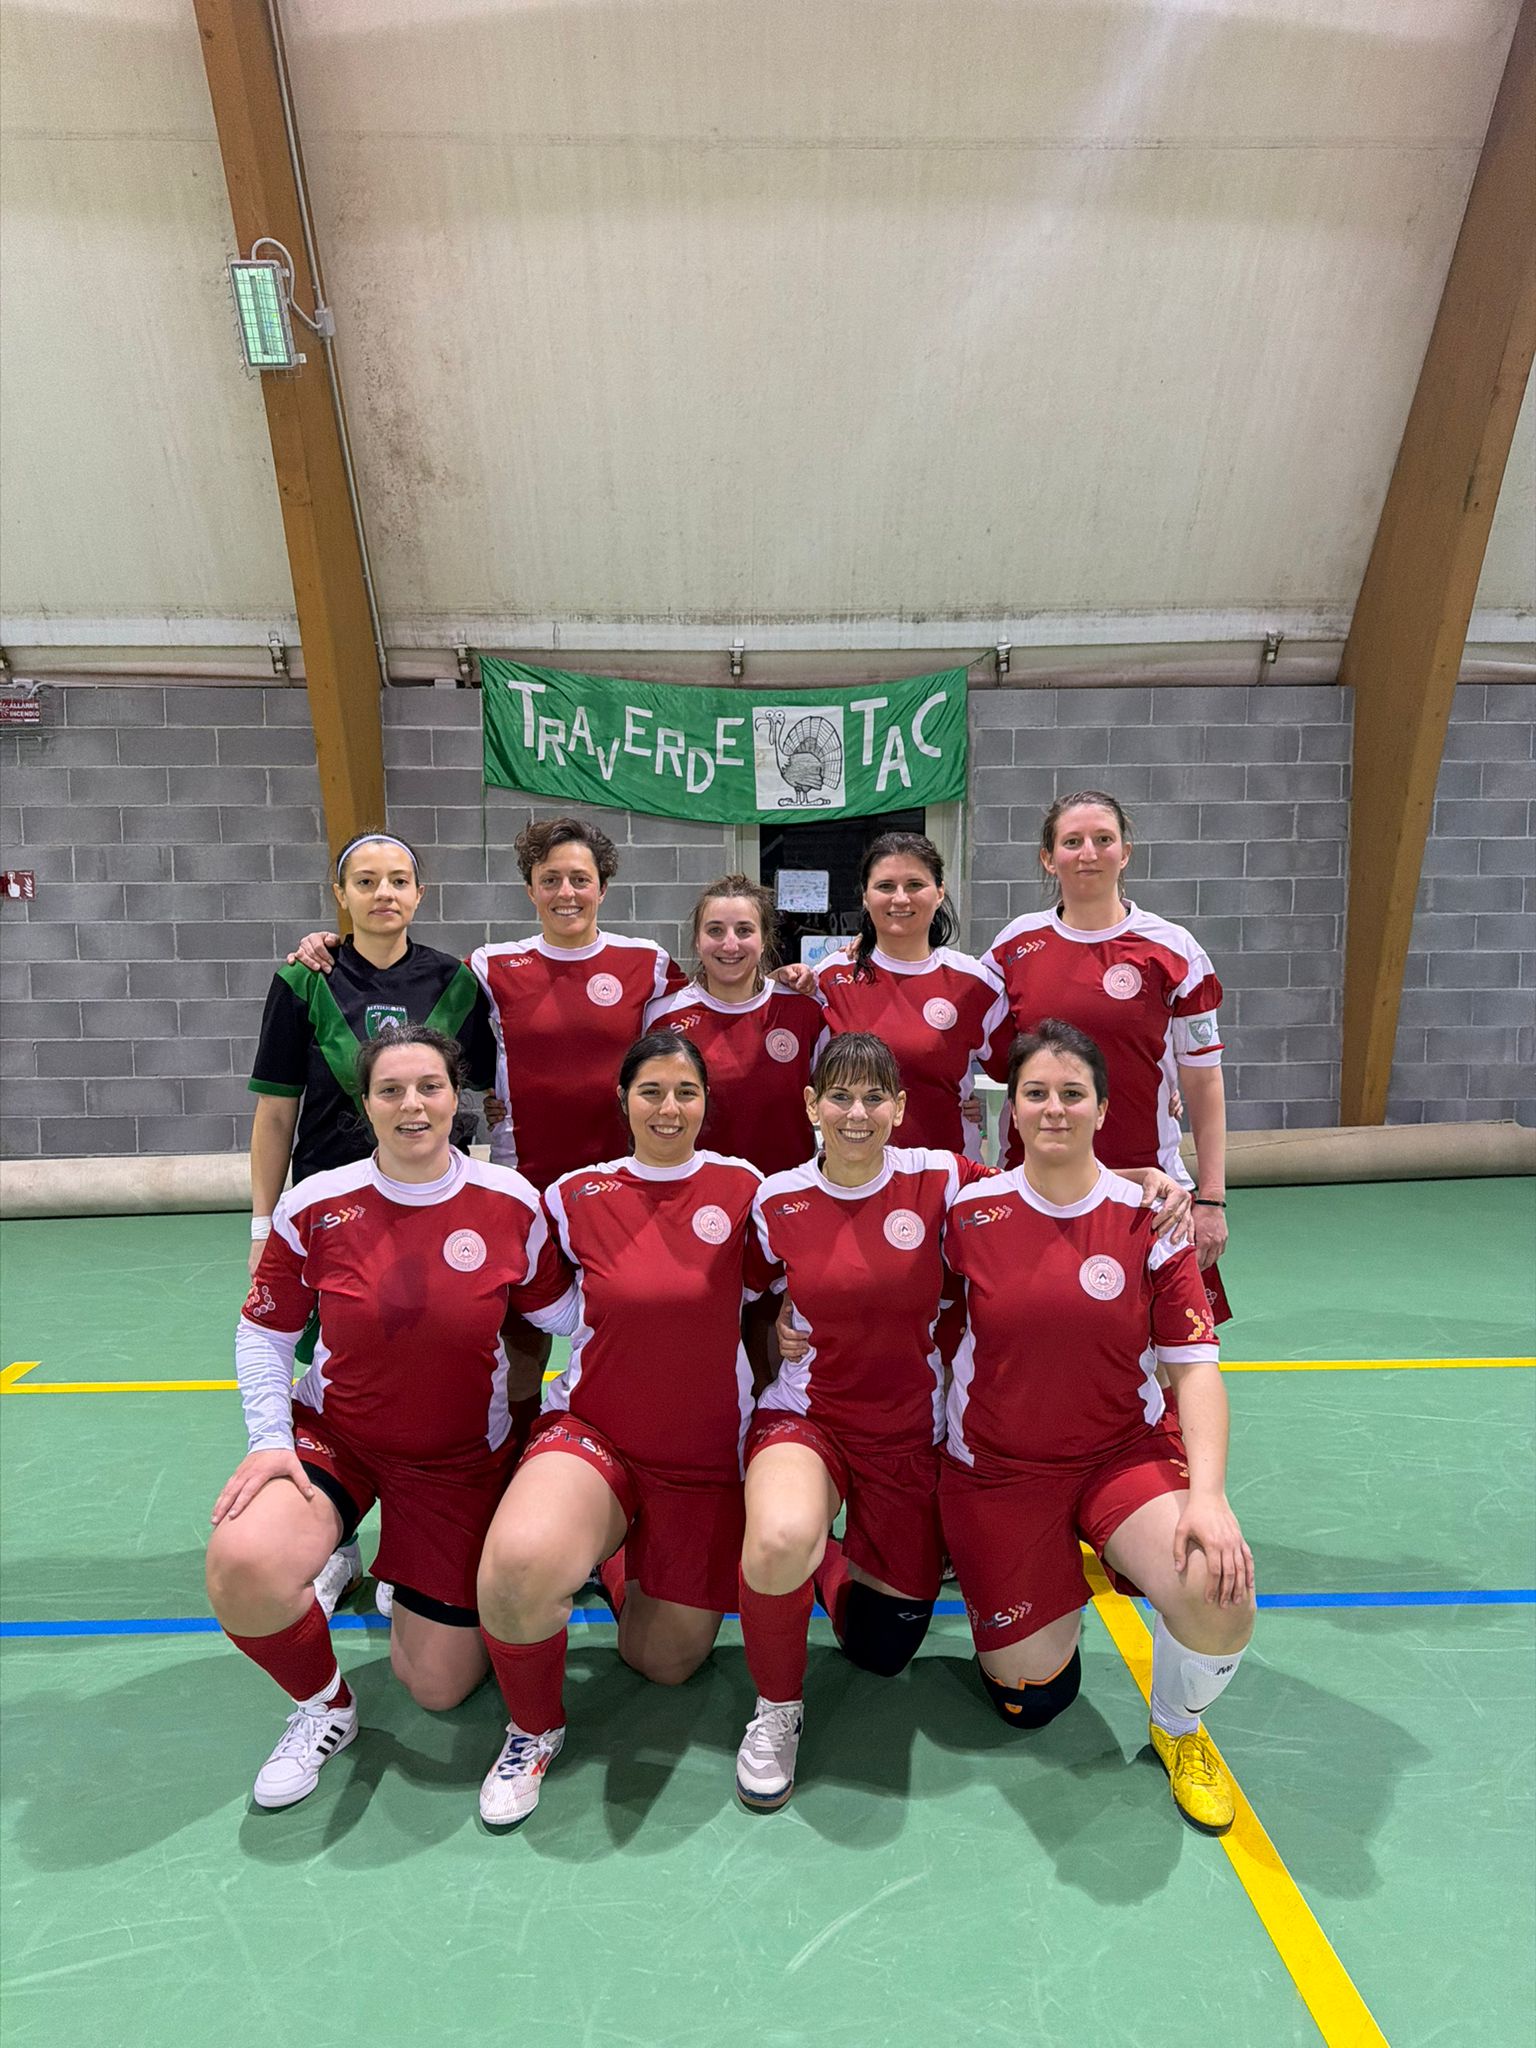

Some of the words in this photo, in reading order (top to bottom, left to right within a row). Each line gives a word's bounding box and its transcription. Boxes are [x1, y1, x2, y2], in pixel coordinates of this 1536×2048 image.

[9, 710, 40, 718] INCENDIO
[508, 680, 745, 794] TRAVERDE
[850, 690, 947, 792] TAC
